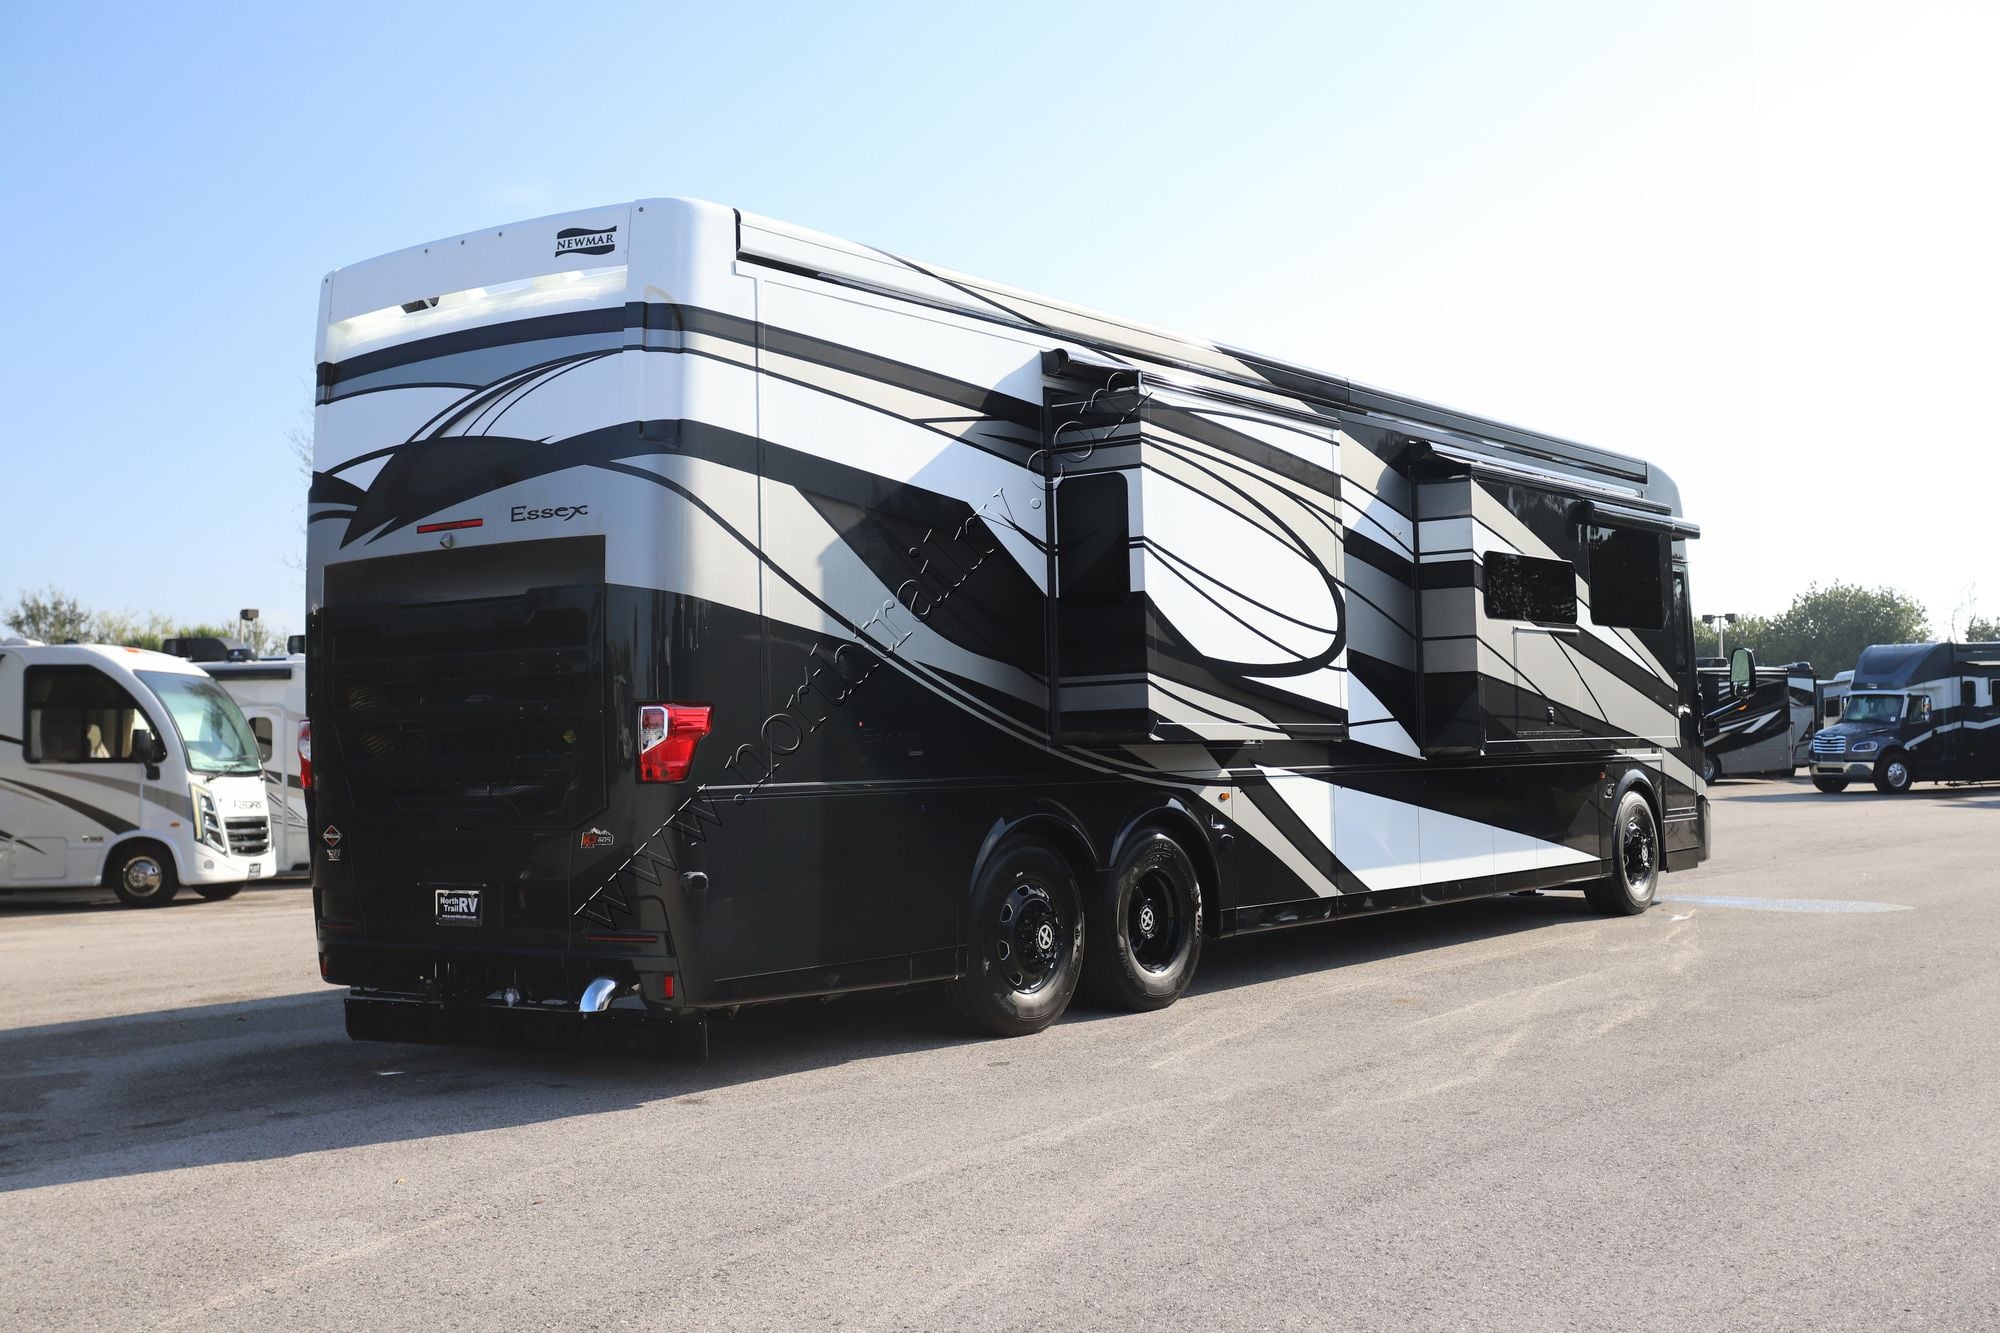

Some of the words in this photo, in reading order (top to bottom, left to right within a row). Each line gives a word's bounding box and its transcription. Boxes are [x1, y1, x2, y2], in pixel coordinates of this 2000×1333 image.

[556, 233, 615, 250] NEWMAR
[510, 504, 589, 522] Essex
[440, 896, 459, 905] North
[443, 904, 459, 912] Trail
[458, 897, 478, 913] RV
